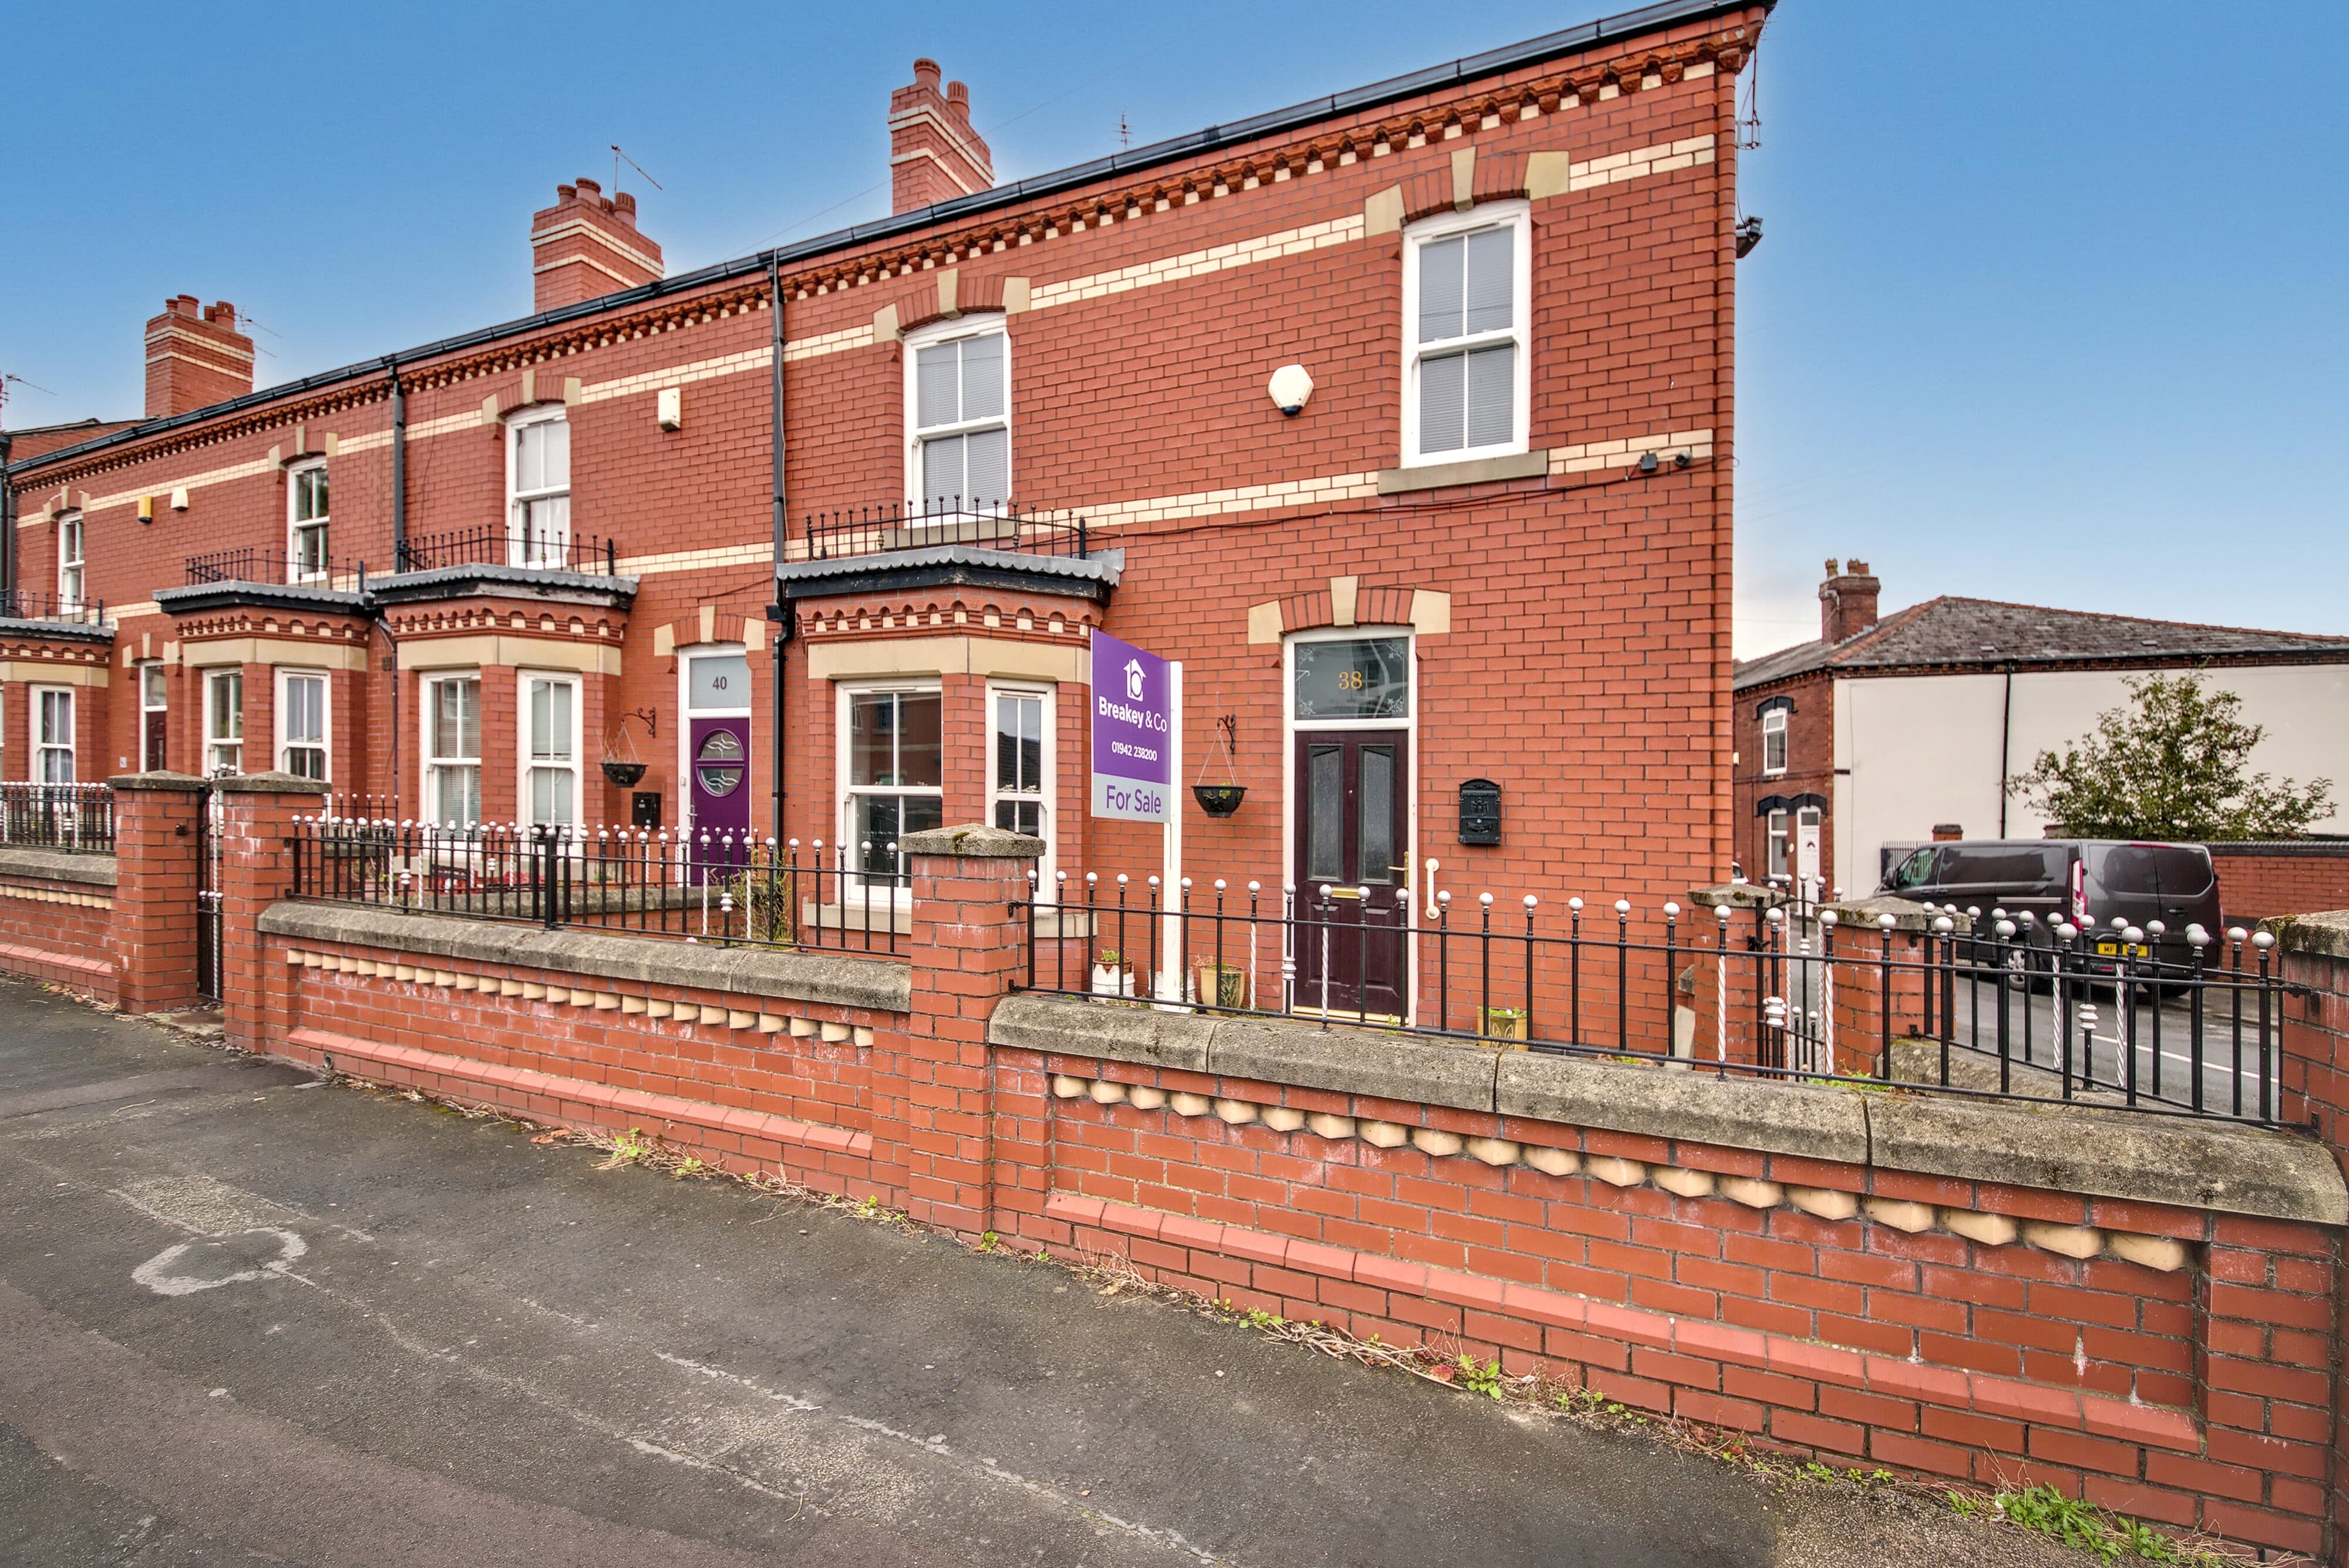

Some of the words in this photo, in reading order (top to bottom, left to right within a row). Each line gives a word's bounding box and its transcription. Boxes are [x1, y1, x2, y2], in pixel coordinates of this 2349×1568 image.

[712, 676, 727, 690] 40
[1339, 671, 1362, 689] 38
[1099, 695, 1144, 729] Breakey
[1145, 710, 1153, 729] &
[1153, 712, 1167, 733] Co
[1111, 741, 1133, 756] 01942
[1133, 745, 1157, 762] 238200
[1106, 785, 1131, 810] For
[1135, 789, 1161, 814] Sale
